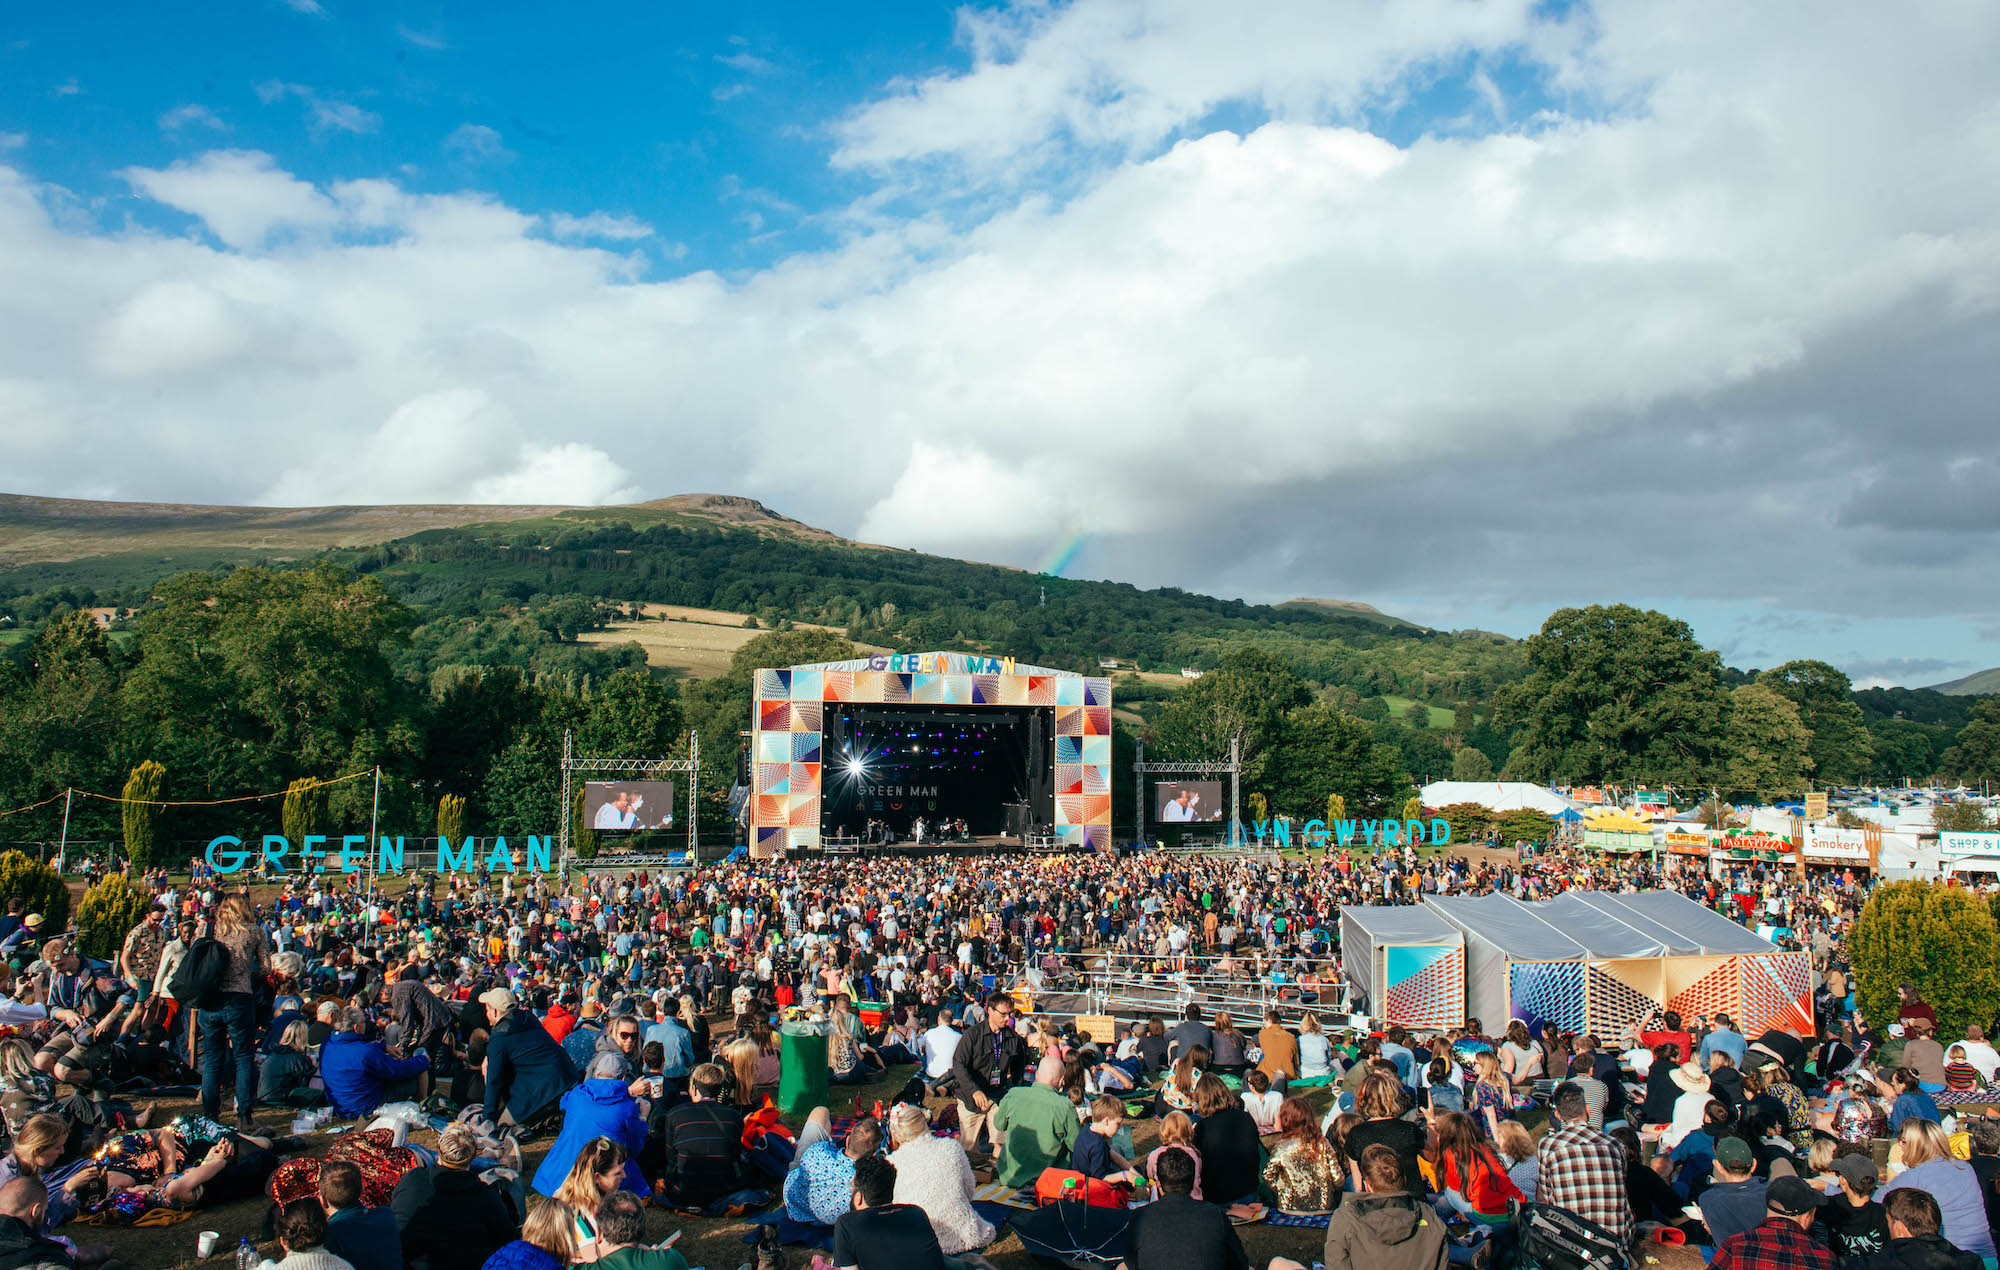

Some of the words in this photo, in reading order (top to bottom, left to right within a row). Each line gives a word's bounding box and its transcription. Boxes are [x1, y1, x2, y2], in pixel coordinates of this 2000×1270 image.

[868, 653, 949, 673] GREEN
[967, 655, 1016, 675] MAN
[856, 785, 903, 797] GREEN
[910, 785, 938, 797] MAN
[1227, 819, 1290, 848] DYN
[1303, 818, 1451, 847] GWYRDD
[204, 834, 405, 873] GREEN
[437, 834, 552, 873] MAN
[1811, 834, 1863, 853] Smokery
[1949, 838, 1980, 849] SHOP
[1983, 839, 1993, 850] &
